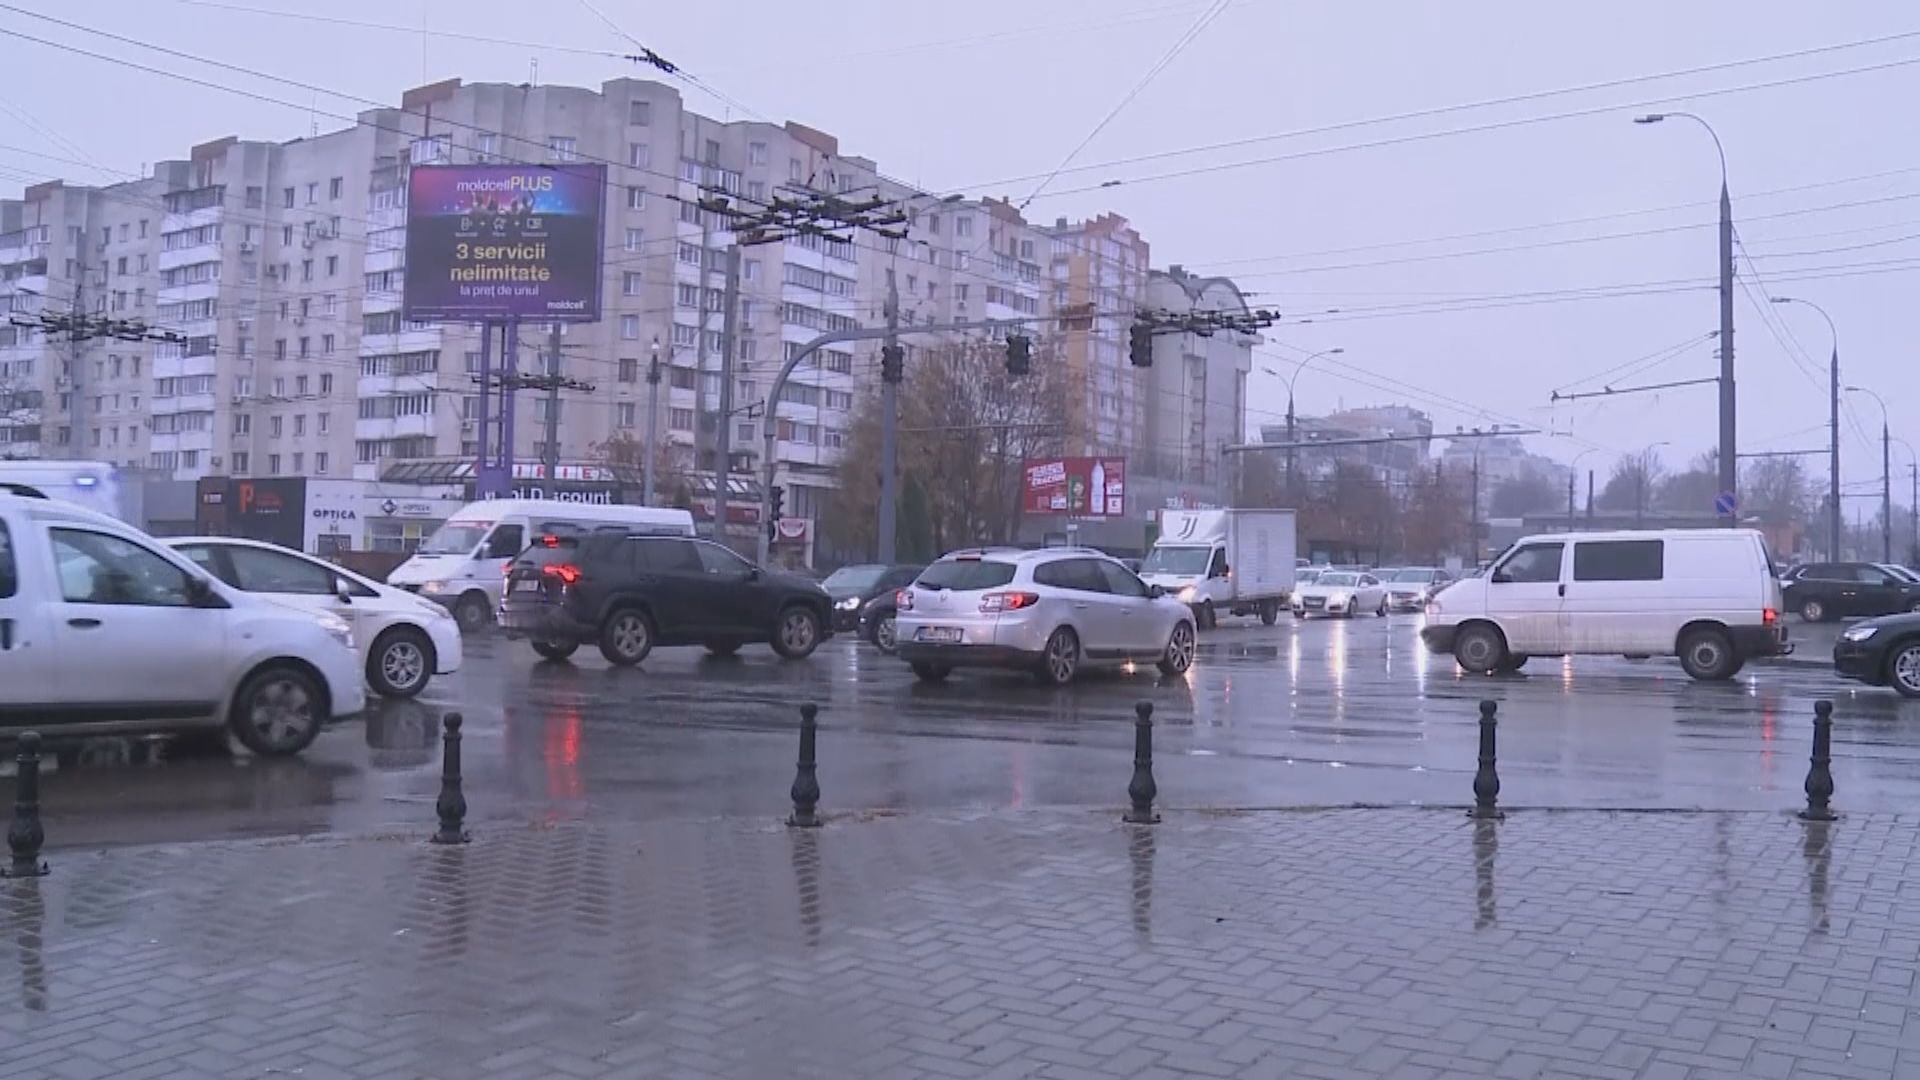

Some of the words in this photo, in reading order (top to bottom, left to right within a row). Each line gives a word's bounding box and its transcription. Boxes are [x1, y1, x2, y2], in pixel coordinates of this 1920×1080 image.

[457, 176, 552, 192] moldcellPLUS
[456, 243, 468, 260] 3
[474, 243, 546, 260] servicii
[451, 264, 551, 281] nelimitate
[460, 285, 470, 295] la
[497, 285, 512, 295] de
[514, 285, 539, 295] unul
[547, 300, 584, 309] moldcell
[312, 509, 356, 520] OPTICA
